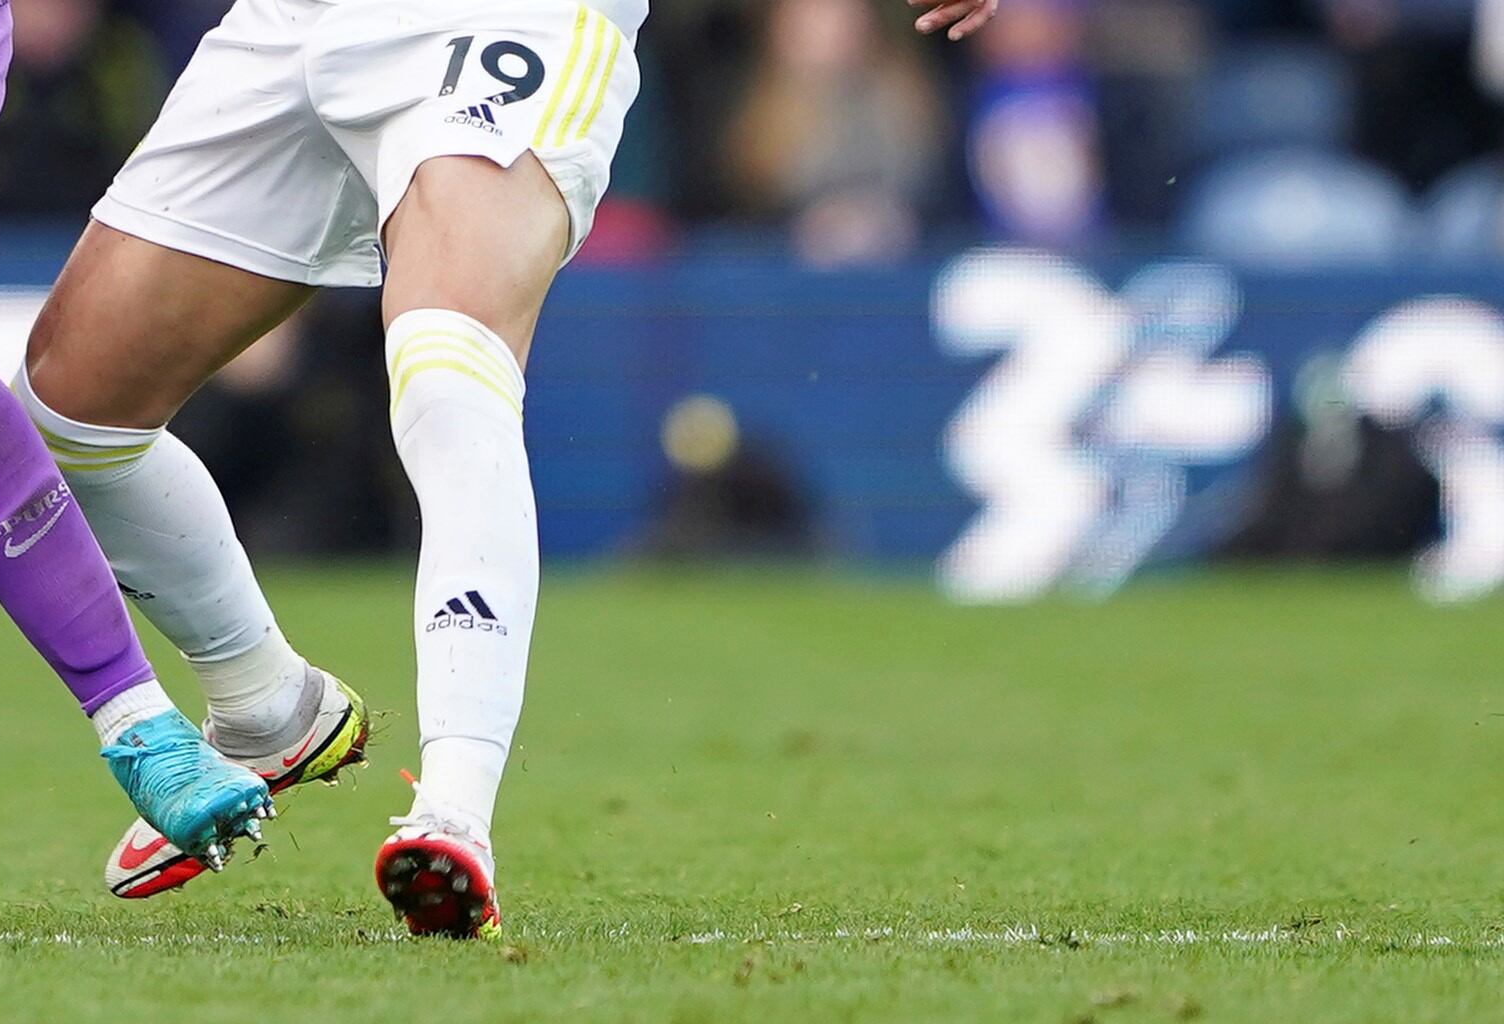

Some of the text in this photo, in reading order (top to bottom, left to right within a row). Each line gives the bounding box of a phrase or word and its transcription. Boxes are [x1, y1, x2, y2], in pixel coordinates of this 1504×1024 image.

[438, 35, 546, 107] 19
[444, 113, 503, 137] adidas
[425, 614, 508, 636] adidas
